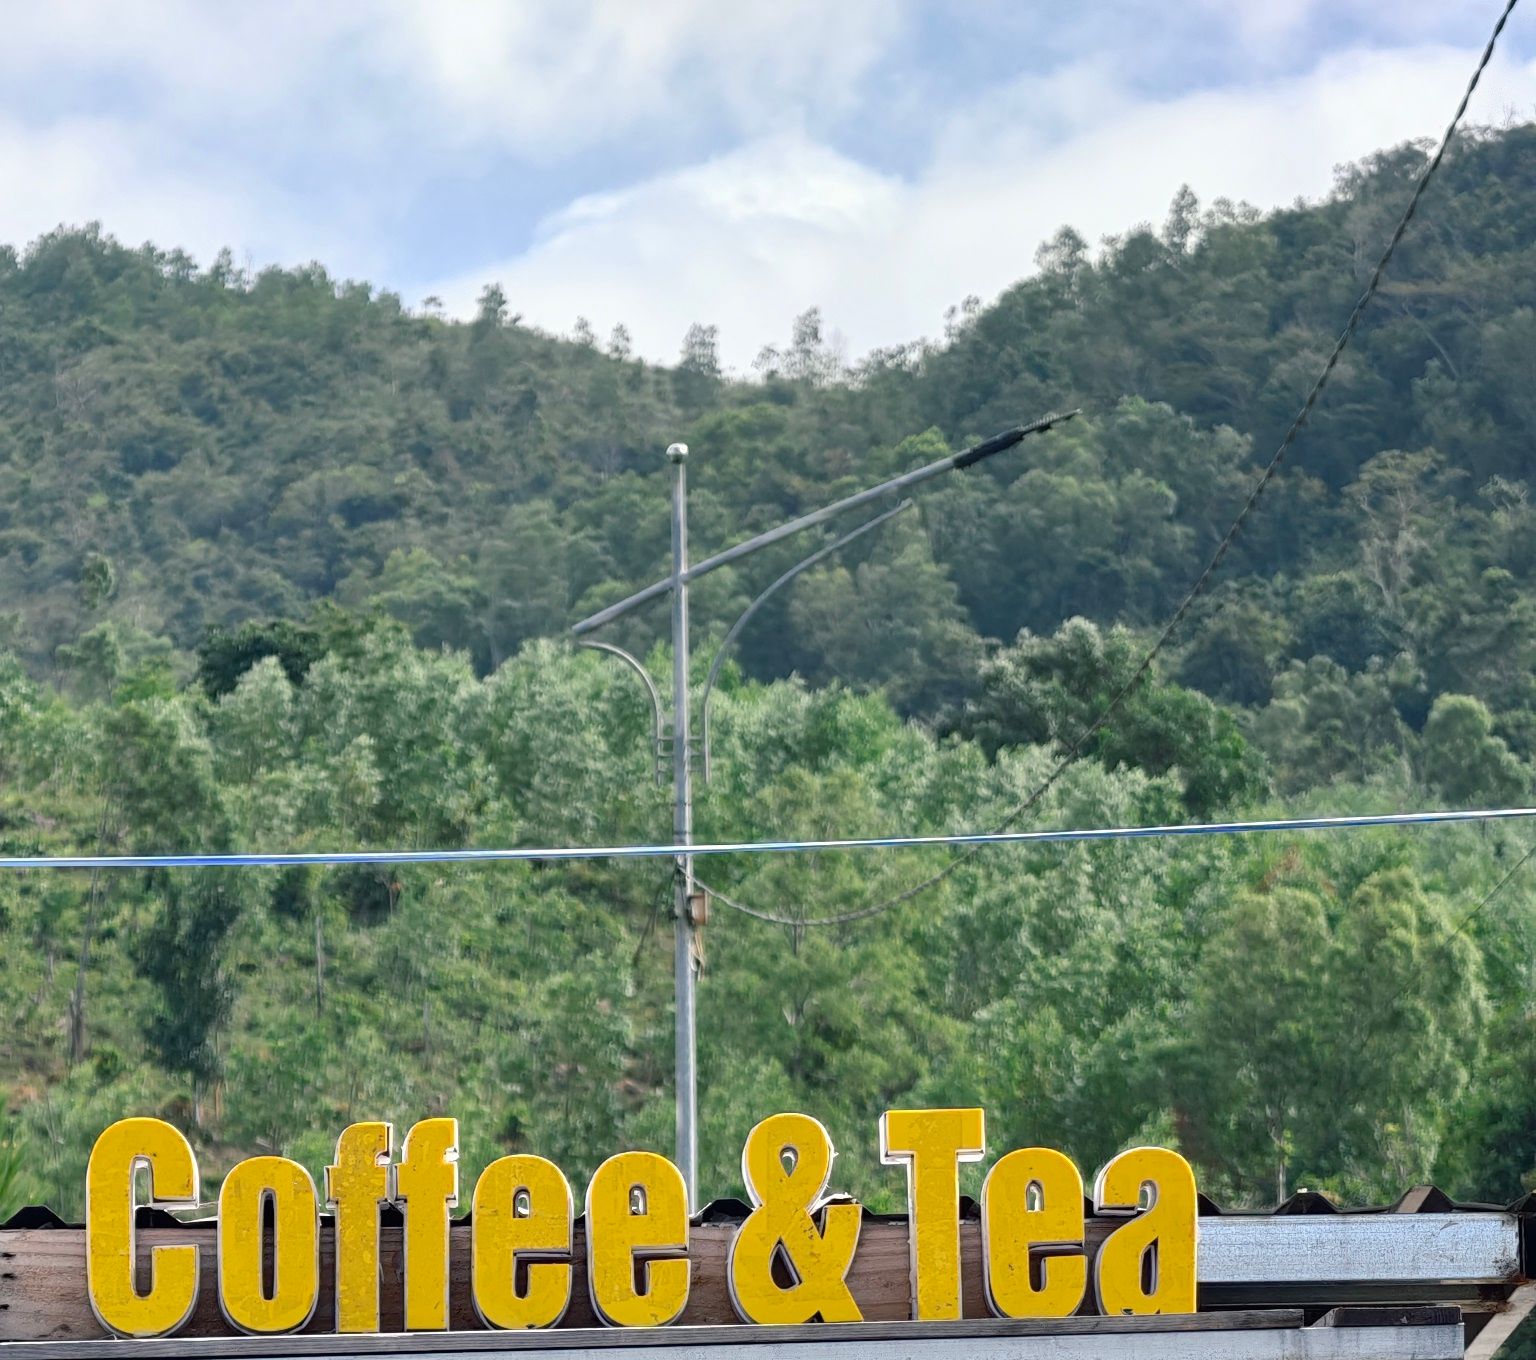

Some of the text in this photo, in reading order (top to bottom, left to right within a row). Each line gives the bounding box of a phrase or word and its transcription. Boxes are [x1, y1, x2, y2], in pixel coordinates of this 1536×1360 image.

[84, 1115, 691, 1339] Coffee
[729, 1111, 865, 1326] &
[877, 1107, 1200, 1323] Tea
